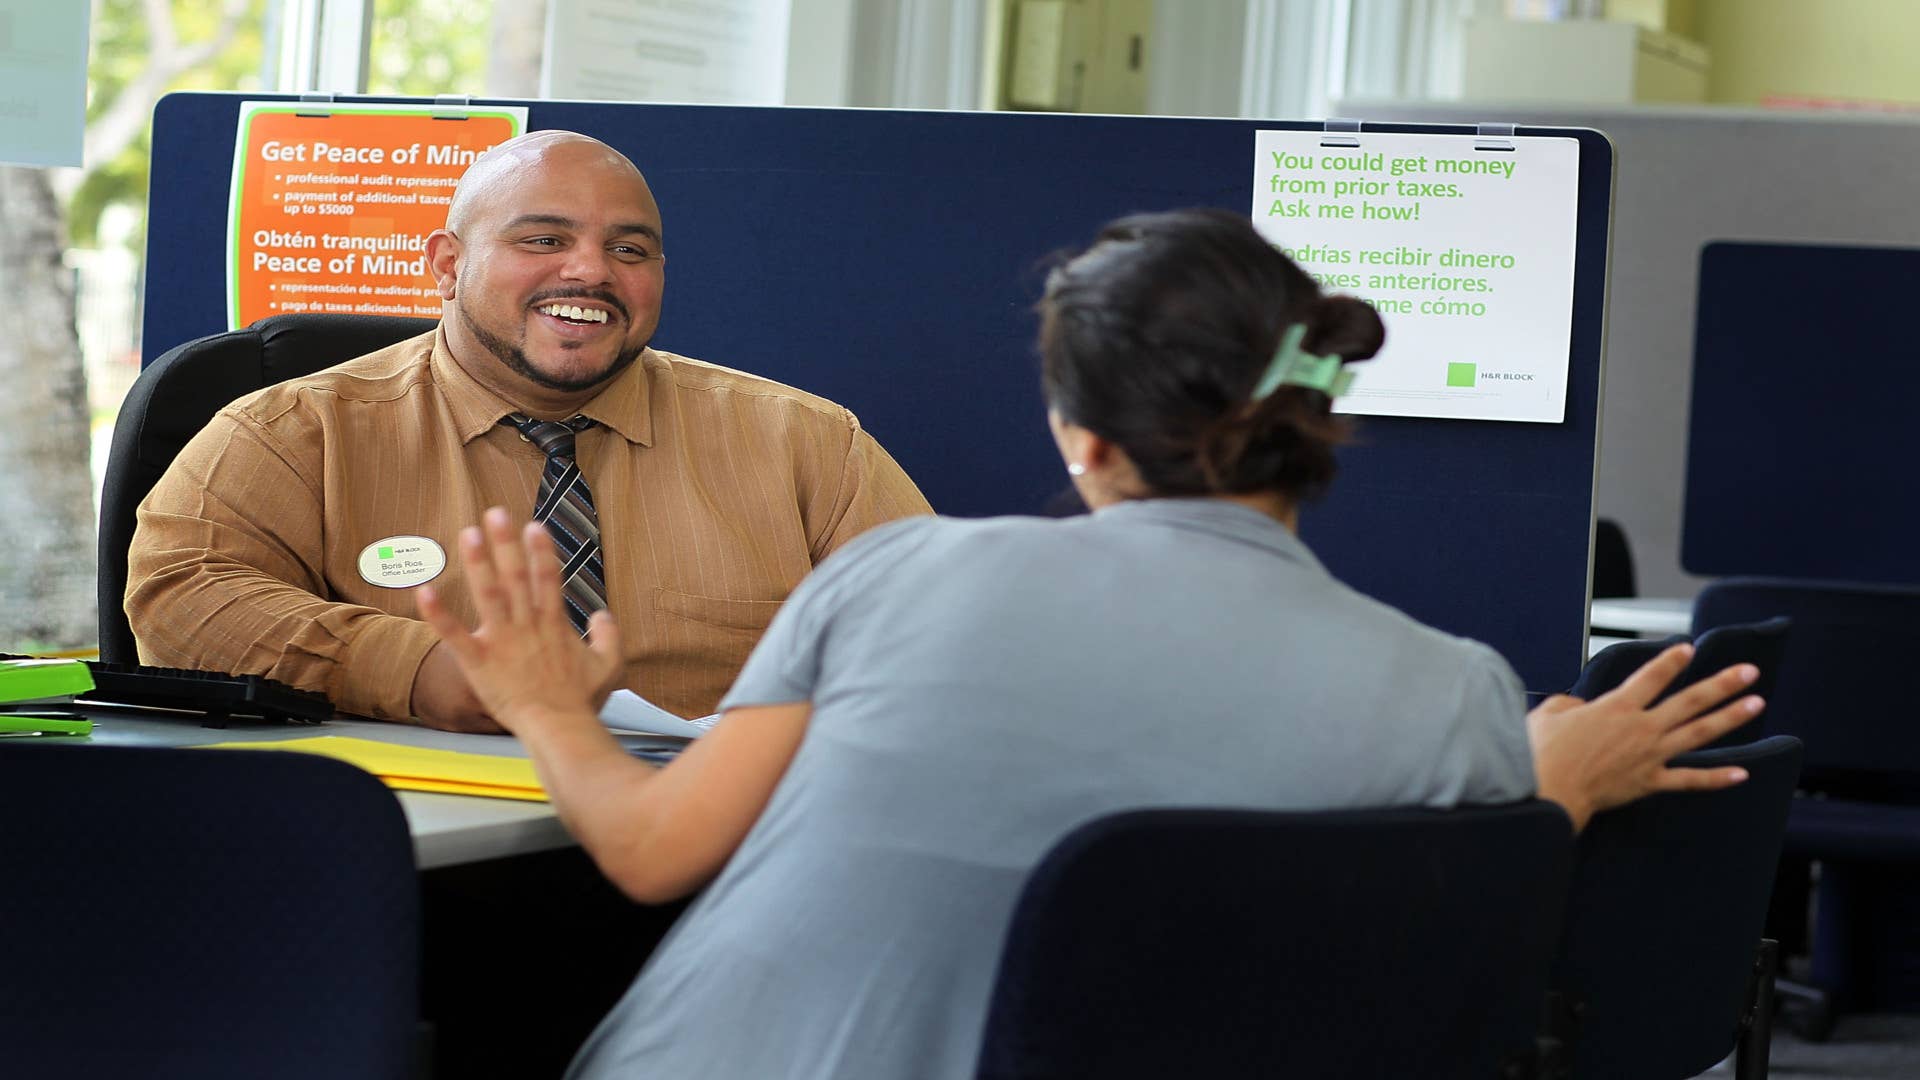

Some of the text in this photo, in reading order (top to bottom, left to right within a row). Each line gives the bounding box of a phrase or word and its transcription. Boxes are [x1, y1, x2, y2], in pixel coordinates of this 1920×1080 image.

[261, 141, 306, 162] Get
[312, 142, 385, 163] Peace
[391, 143, 420, 165] of
[1271, 151, 1516, 179] You could get money
[285, 172, 359, 186] professional
[361, 174, 393, 186] audit
[1270, 174, 1464, 199] from prior taxes.
[284, 191, 451, 205] payment of additional taxes
[283, 204, 355, 216] up to $5000
[1268, 198, 1421, 221] Ask me how!
[253, 230, 317, 248] Obtén
[253, 251, 425, 277] Peace of Mind
[1271, 244, 1516, 269] odrías recibir dinero
[280, 283, 357, 294] representación
[359, 284, 373, 294] de
[1303, 270, 1494, 293] axes anteriores.
[281, 301, 442, 315] pago de taxes adicionales hasta
[1420, 298, 1487, 317] cómo
[1481, 372, 1534, 381] H&R BLOCK
[404, 560, 423, 568] Rios
